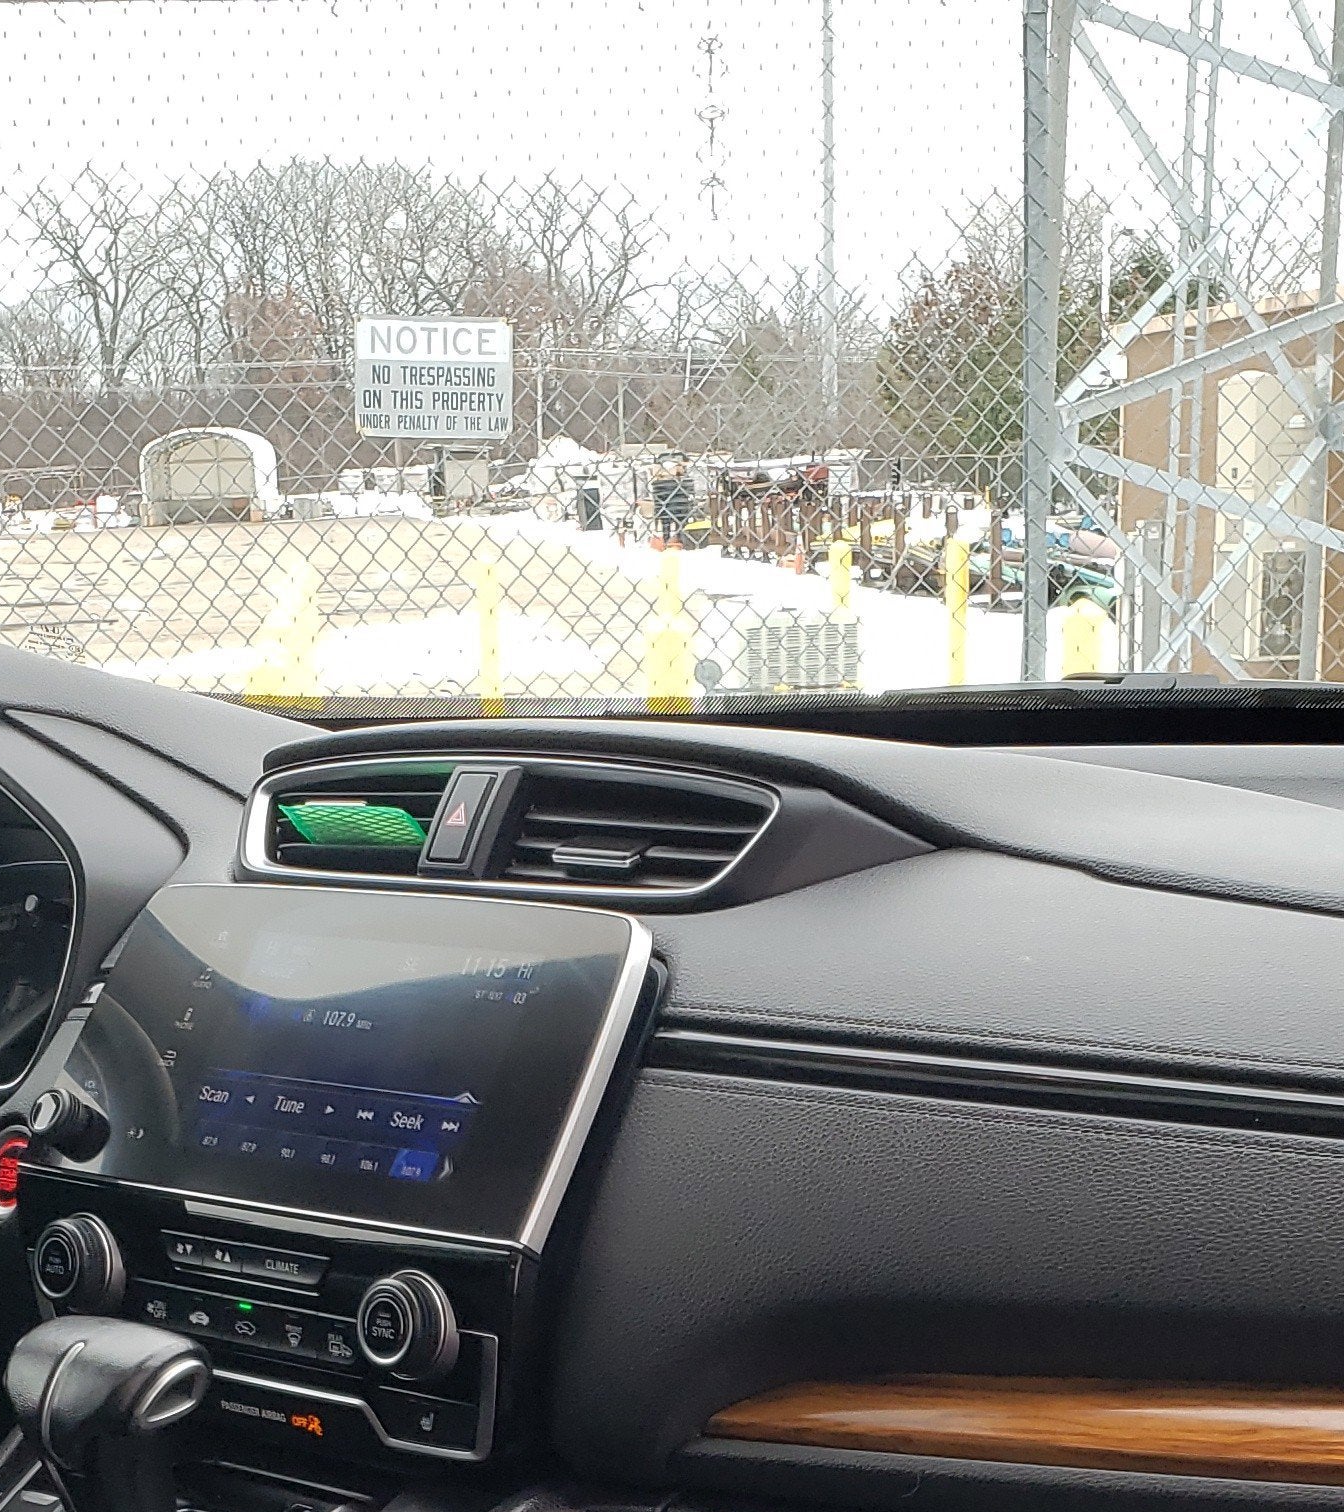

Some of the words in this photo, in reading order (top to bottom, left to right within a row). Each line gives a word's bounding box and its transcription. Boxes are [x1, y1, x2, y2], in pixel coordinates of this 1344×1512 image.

[370, 325, 497, 356] NOTICE
[372, 364, 390, 385] NO
[400, 365, 496, 387] TRESPASSING
[363, 389, 382, 409] ON
[391, 390, 423, 410] THIS
[432, 391, 504, 412] PROPERTY
[359, 413, 391, 430] UNDER
[398, 414, 440, 431] PENALTY
[446, 415, 458, 431] OF
[464, 416, 481, 431] THE
[488, 416, 509, 432] LAW
[323, 1010, 356, 1027] 107.9
[199, 1085, 230, 1104] Scan
[273, 1095, 305, 1114] Tune
[390, 1110, 426, 1130] Seek
[266, 1259, 300, 1276] CLIMATE
[372, 1326, 395, 1340] SYNC
